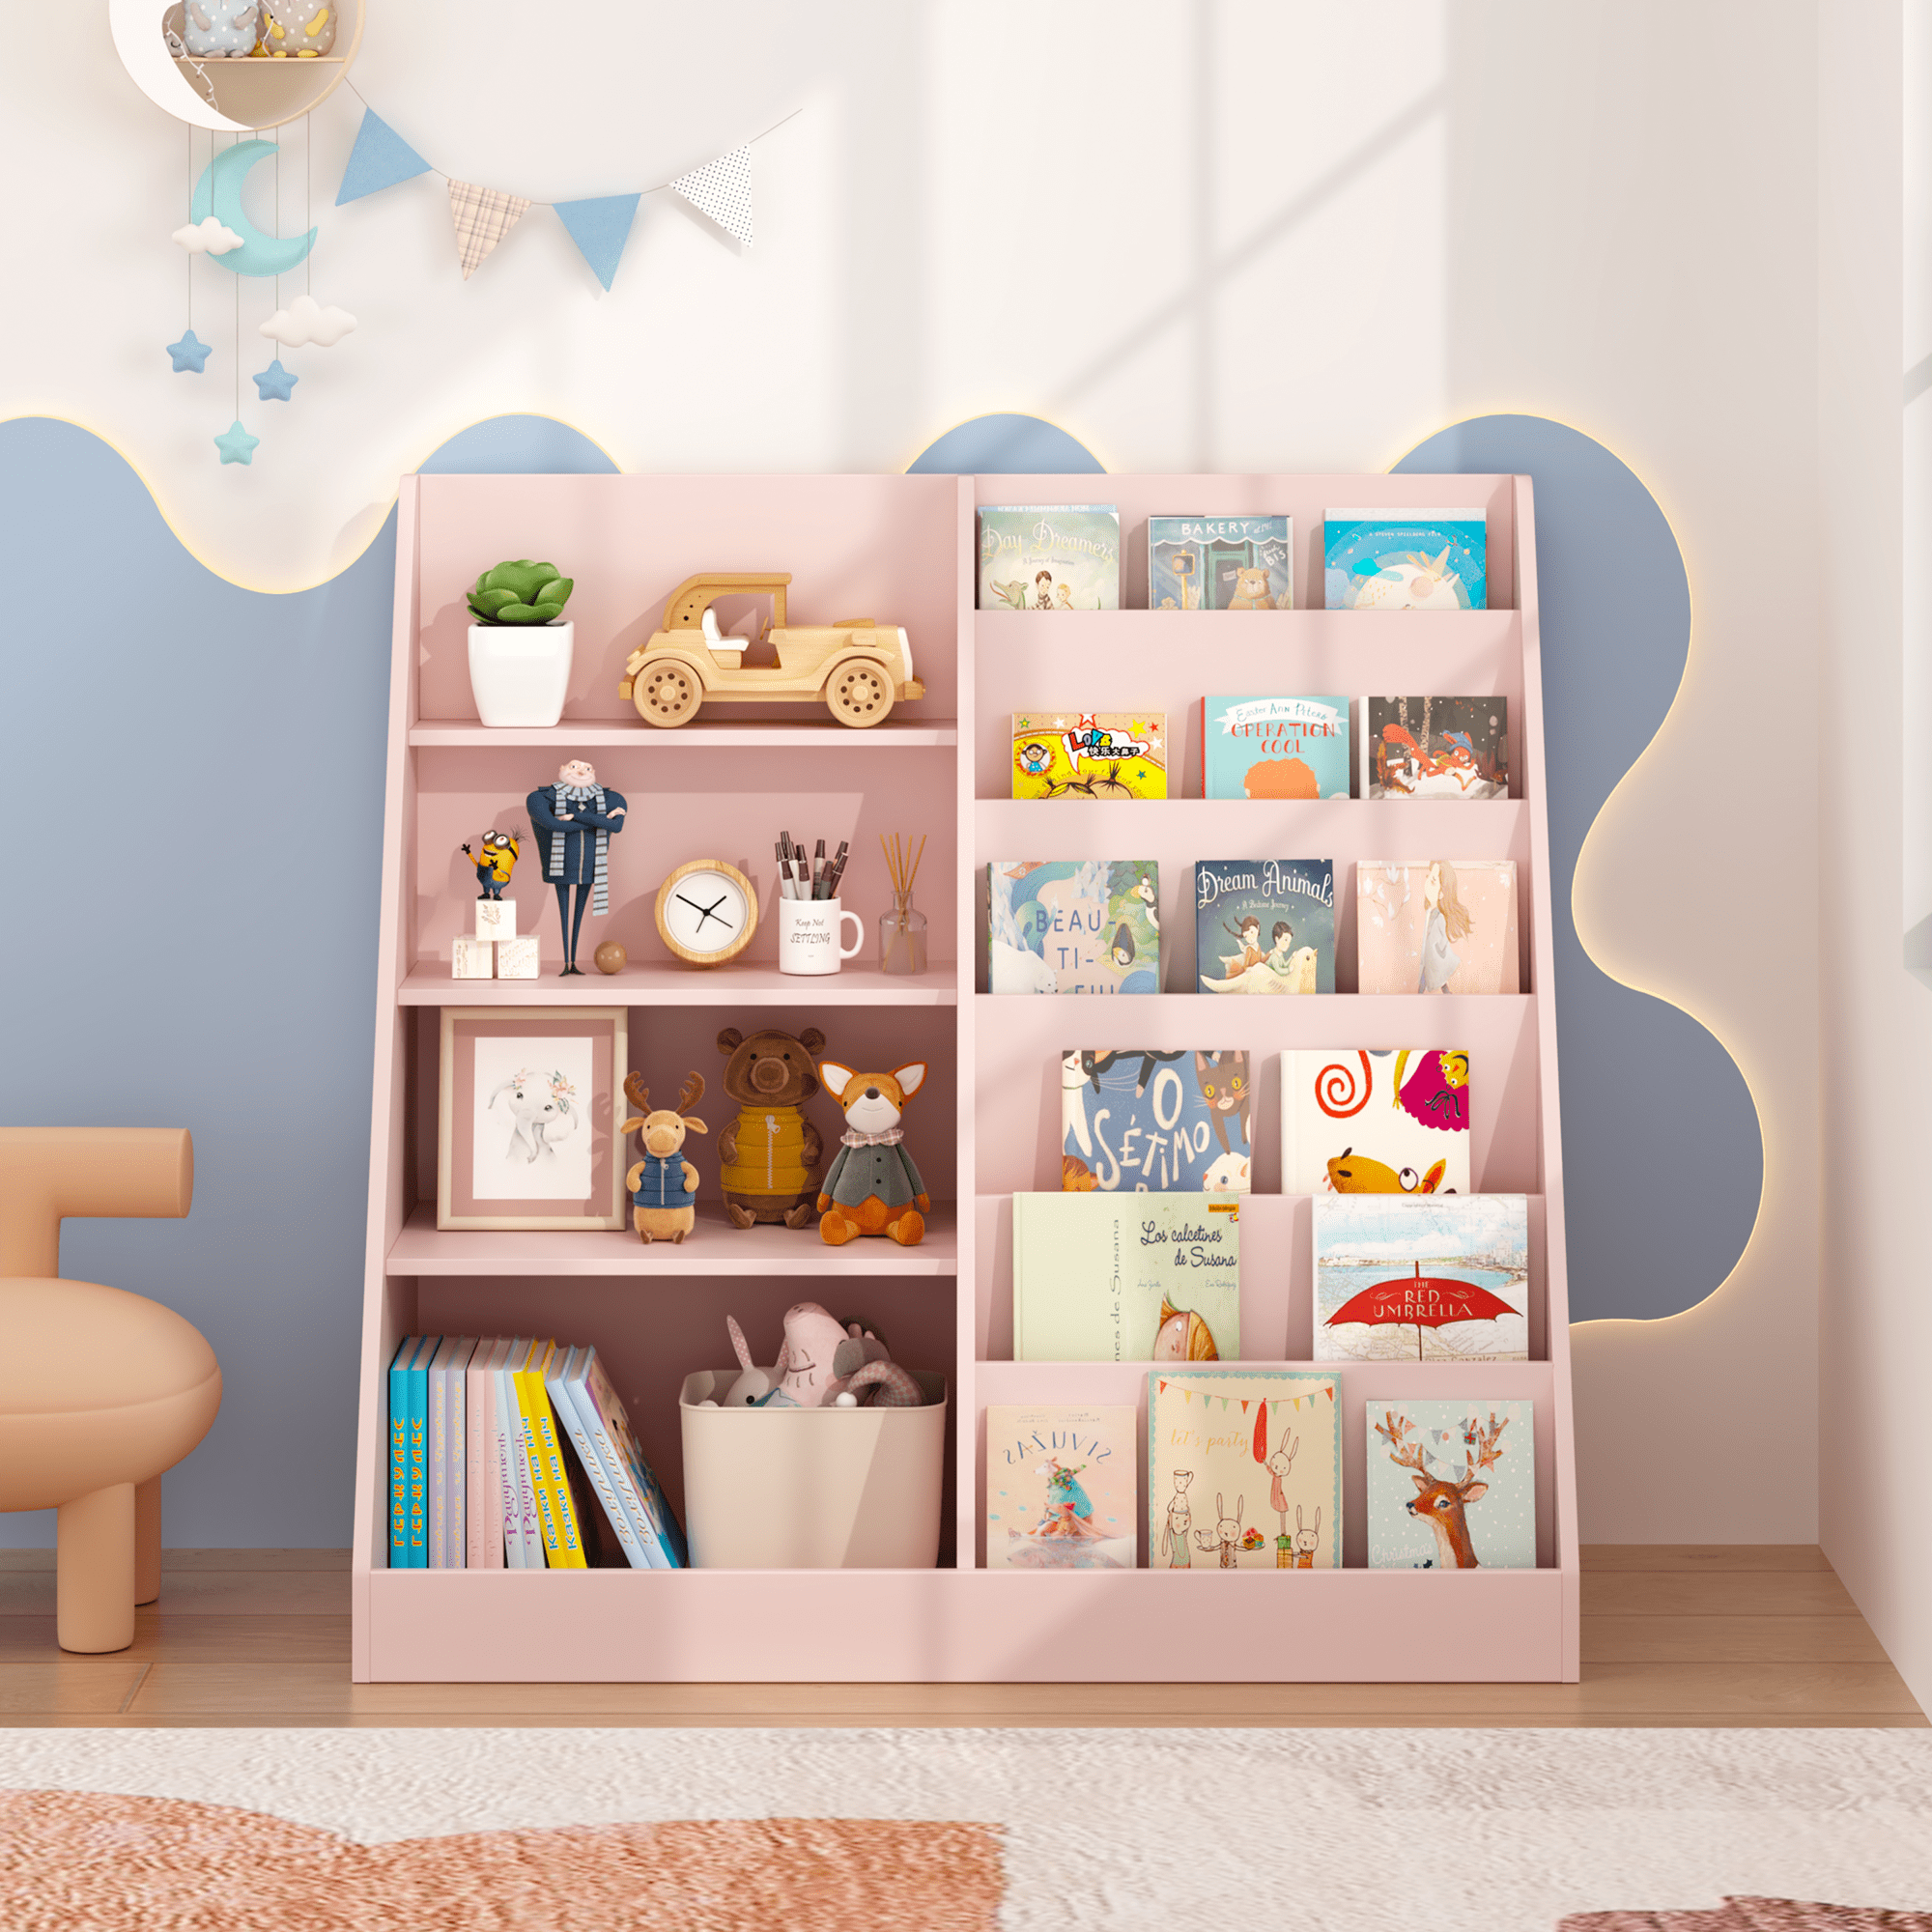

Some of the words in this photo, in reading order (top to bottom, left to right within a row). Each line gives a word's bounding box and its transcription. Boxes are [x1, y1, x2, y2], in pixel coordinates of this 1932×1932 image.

[980, 524, 1022, 558] Day
[1031, 518, 1114, 562] Dreamers
[1181, 522, 1250, 535] BAKERY
[1236, 706, 1266, 723] Easter
[1231, 723, 1335, 737] OPERATION
[1088, 746, 1140, 757] 快乐大鼻子
[1261, 739, 1305, 753] COOL
[1197, 866, 1259, 910] Dream
[1262, 859, 1333, 908] Animals
[790, 932, 831, 945] SETTLING
[1152, 1067, 1183, 1130] O
[1140, 1220, 1168, 1246] Los
[1171, 1223, 1223, 1243] calcetines
[1109, 1219, 1122, 1295] Susana
[1174, 1247, 1187, 1266] de
[1190, 1246, 1237, 1268] Susana
[1405, 1290, 1440, 1303] RED
[1110, 1301, 1121, 1324] de
[1373, 1304, 1473, 1321] UMBRELLA
[521, 1416, 535, 1448] ніч
[539, 1416, 554, 1448] ніч
[1171, 1428, 1201, 1447] let's
[1206, 1431, 1249, 1458] party
[529, 1455, 543, 1481] на
[548, 1455, 562, 1481] на
[393, 1417, 405, 1547] ГЕРКУЛЕС
[412, 1417, 423, 1547] ГЕРКУЛЕС
[538, 1489, 559, 1550] Казки
[555, 1489, 578, 1550] Казки
